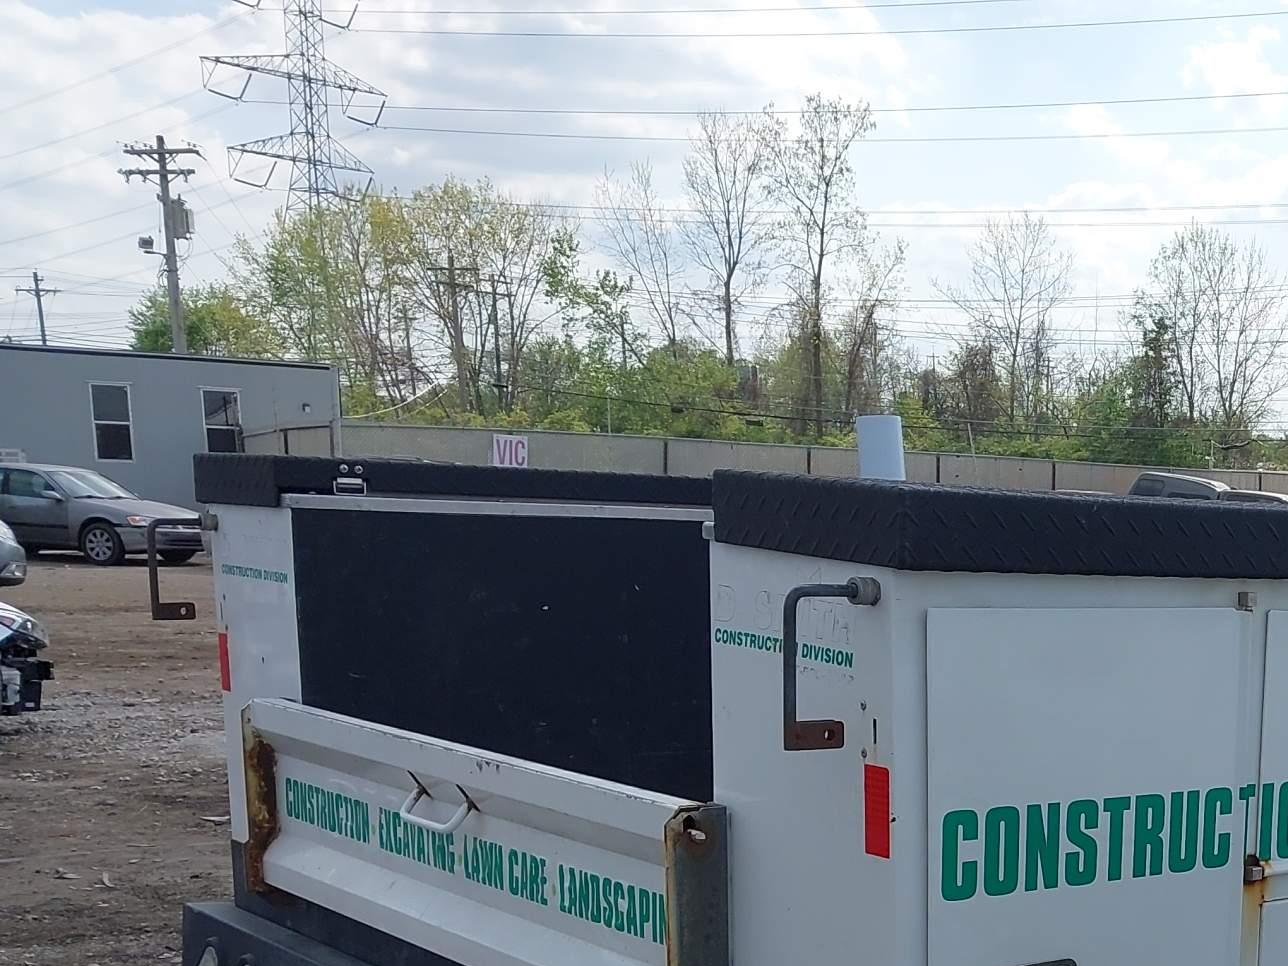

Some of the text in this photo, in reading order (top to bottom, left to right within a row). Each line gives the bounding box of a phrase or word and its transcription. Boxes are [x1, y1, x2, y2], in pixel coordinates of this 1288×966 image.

[496, 439, 526, 466] VIC
[263, 570, 288, 584] DIVISION
[714, 628, 854, 668] CONSTRUCTI DIVISION
[285, 777, 666, 945] CONSTRUCTION EXCAVATING LAWN CARE LANDSCAPIN
